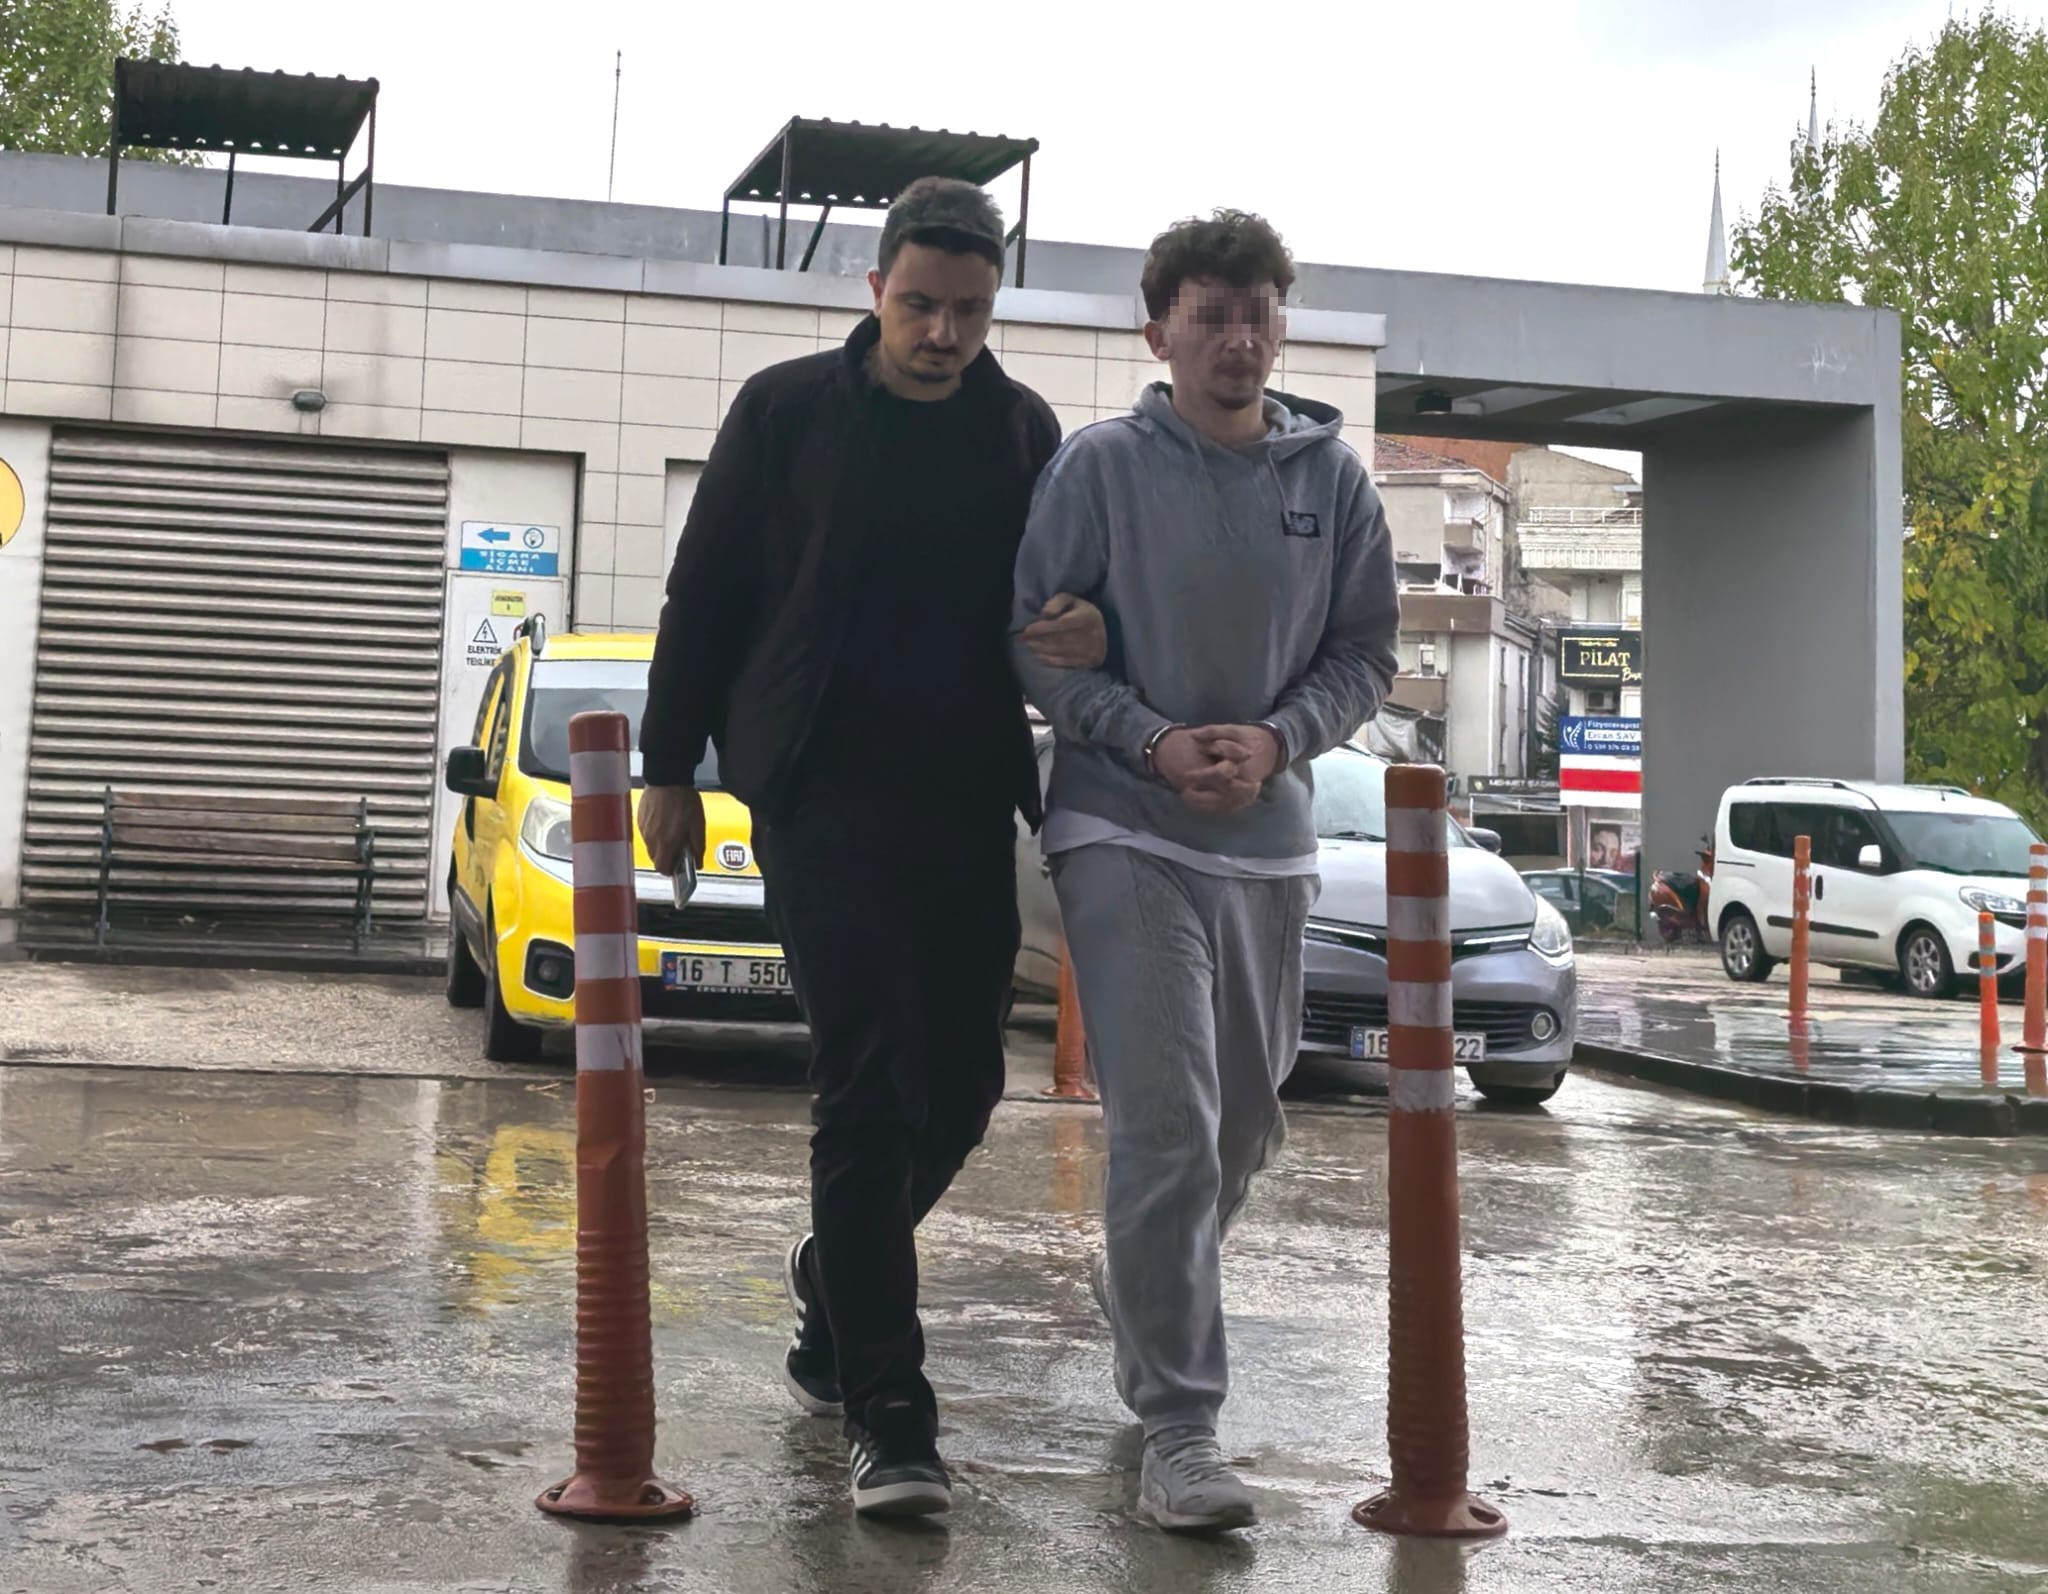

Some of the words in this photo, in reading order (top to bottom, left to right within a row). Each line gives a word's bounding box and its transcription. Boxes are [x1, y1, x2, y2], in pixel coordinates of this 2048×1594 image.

[485, 564, 534, 574] ALANI
[725, 850, 744, 862] FIAT
[679, 959, 703, 981] 16
[720, 961, 733, 983] T
[750, 962, 789, 986] 550
[1455, 1038, 1480, 1059] 22
